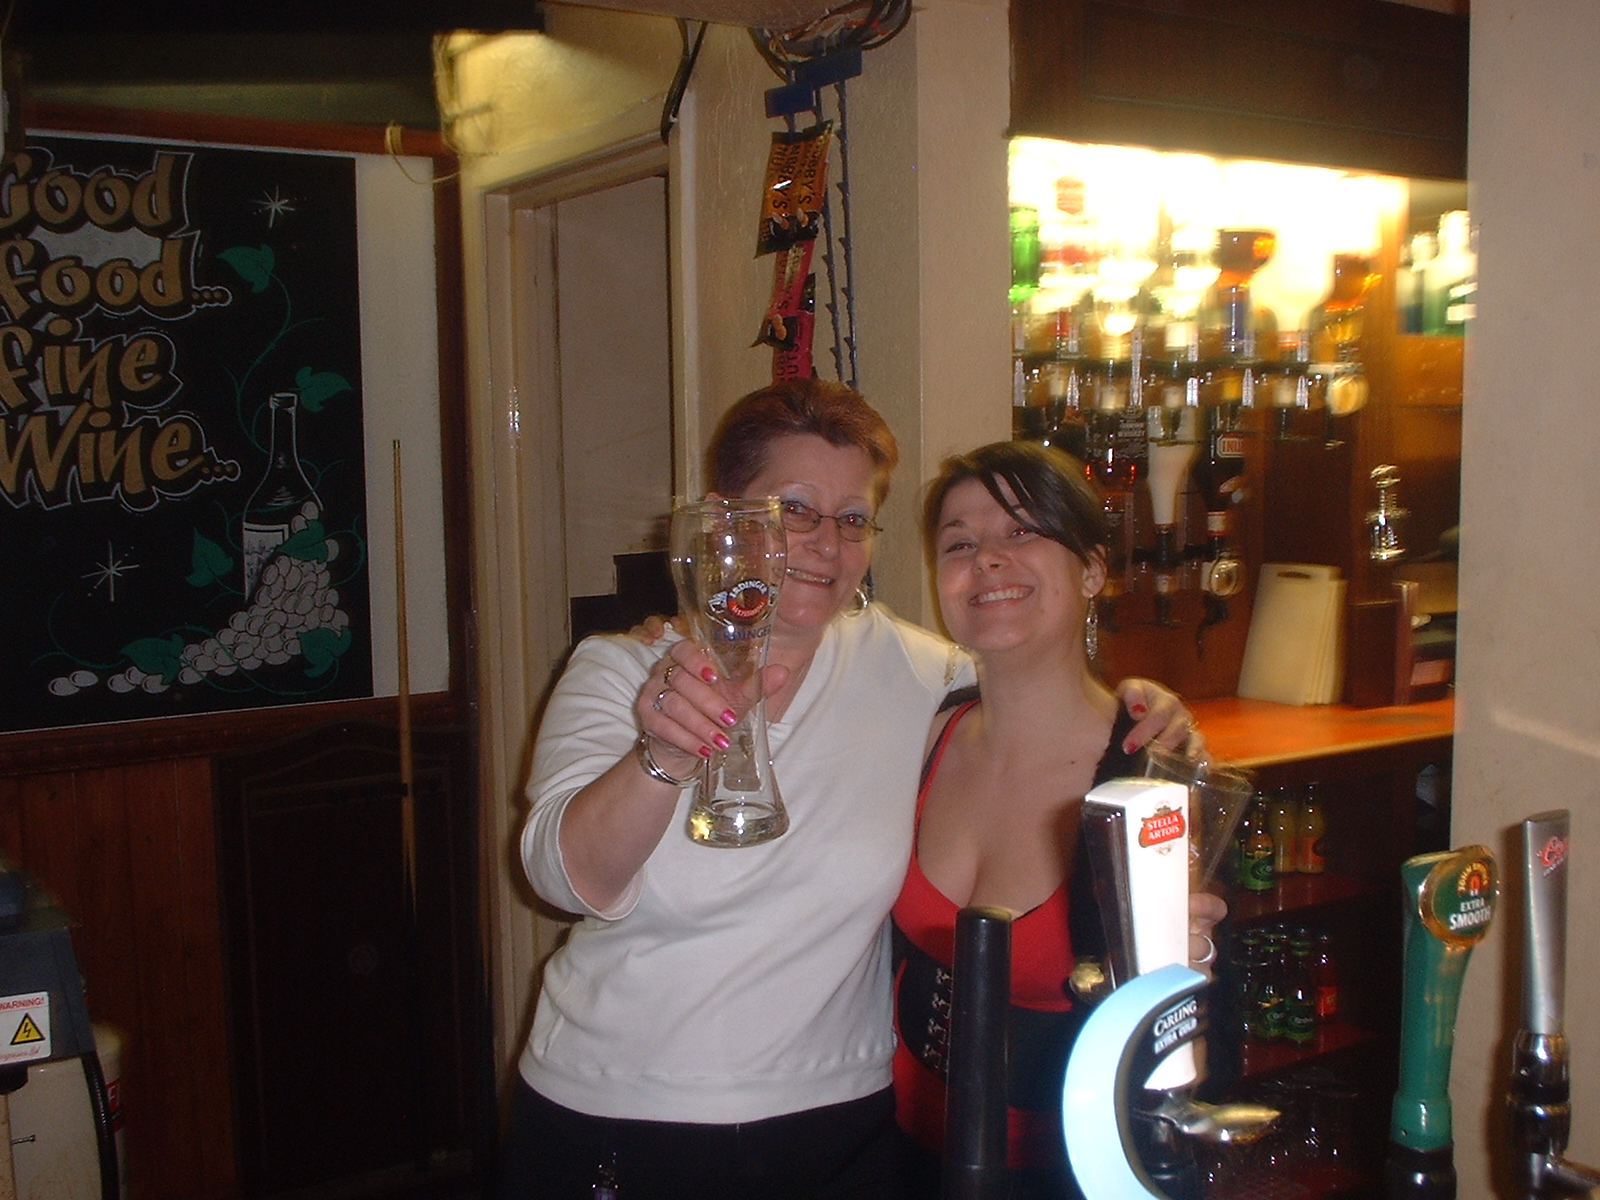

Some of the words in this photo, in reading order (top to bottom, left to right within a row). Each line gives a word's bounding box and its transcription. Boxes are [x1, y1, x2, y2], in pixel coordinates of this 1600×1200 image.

[1147, 814, 1179, 831] STELLA
[1148, 825, 1180, 840] ARTOIS
[1460, 898, 1485, 912] EXTRA
[1449, 906, 1491, 931] SMOOTH
[1153, 1000, 1198, 1037] CARLING
